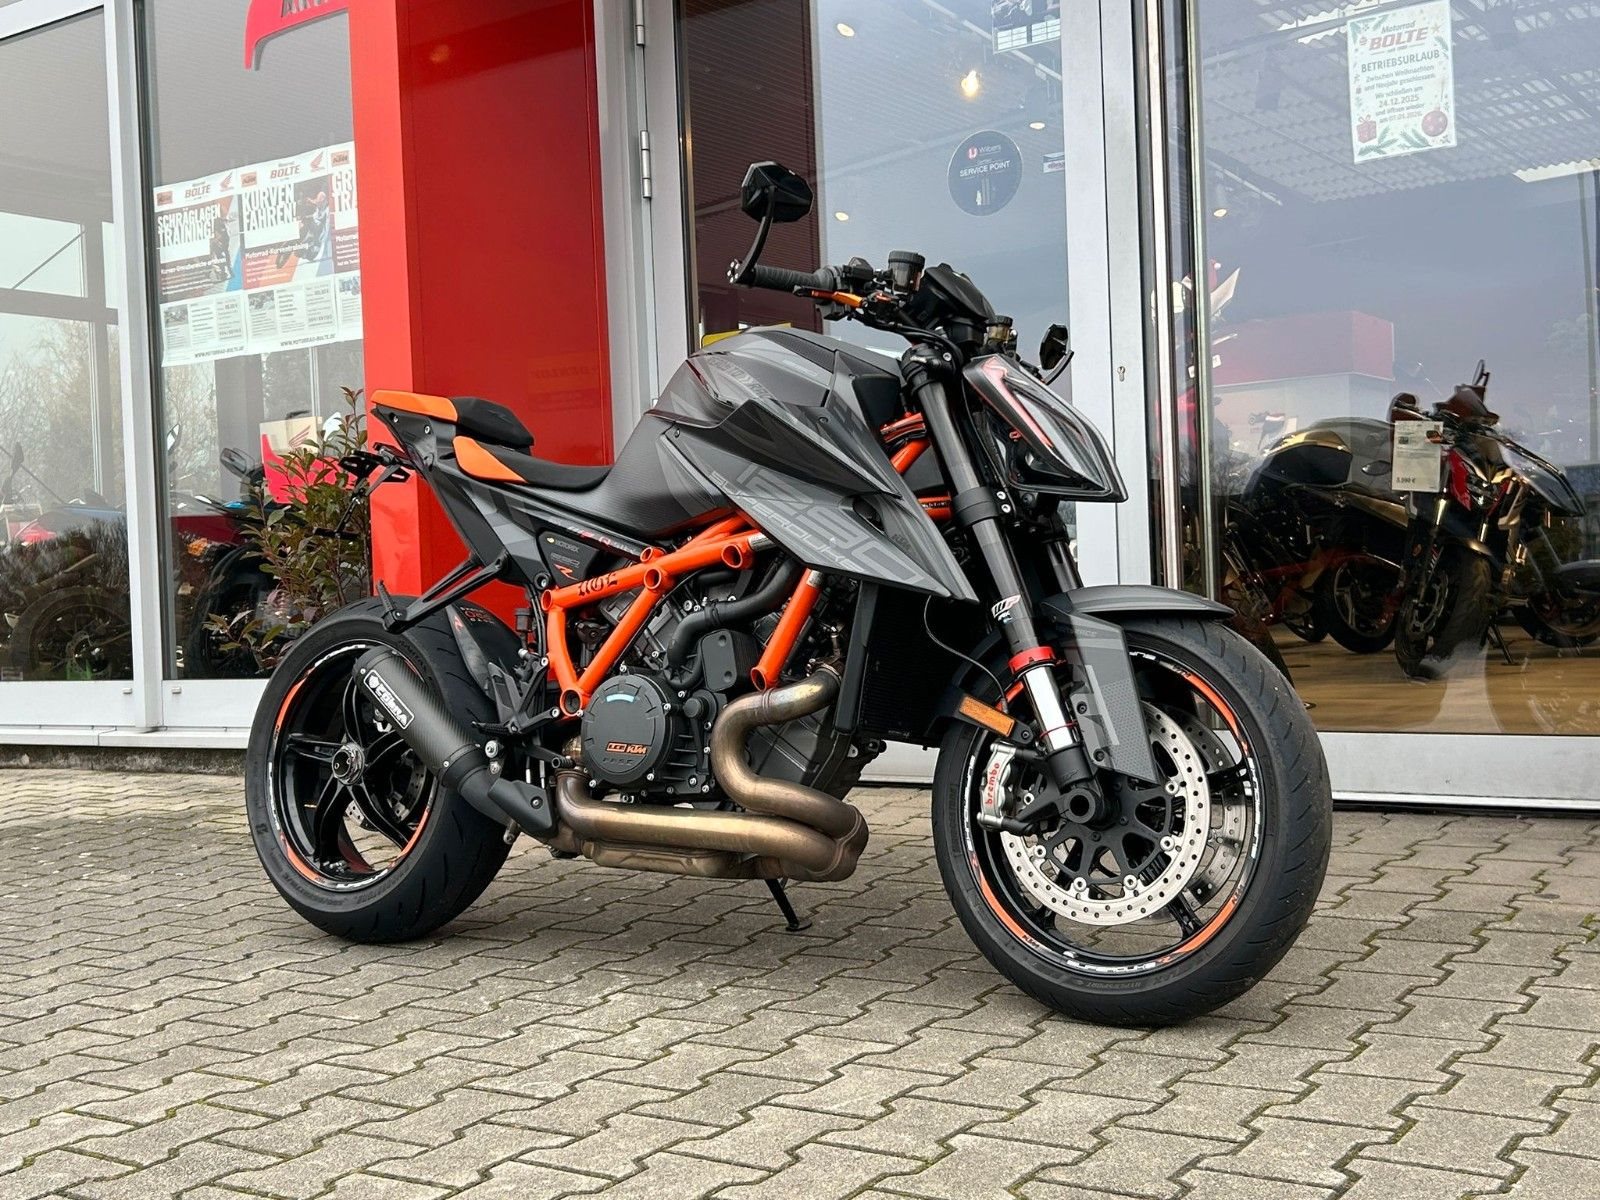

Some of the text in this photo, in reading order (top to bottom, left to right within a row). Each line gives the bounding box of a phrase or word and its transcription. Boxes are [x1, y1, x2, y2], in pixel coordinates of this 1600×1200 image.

[1369, 27, 1428, 51] BOLTE
[1361, 49, 1440, 73] BETRIEBSURLAUB
[270, 164, 300, 179] BOLTE
[959, 164, 988, 178] SERVICE
[989, 159, 1010, 171] POINT
[184, 184, 211, 199] BOLTE
[242, 183, 295, 212] KURVEN
[157, 204, 221, 231] SCHRÄGLAGEN
[243, 202, 297, 231] FAHREN!
[158, 218, 215, 248] TRAINING!
[984, 761, 1000, 805] brembo
